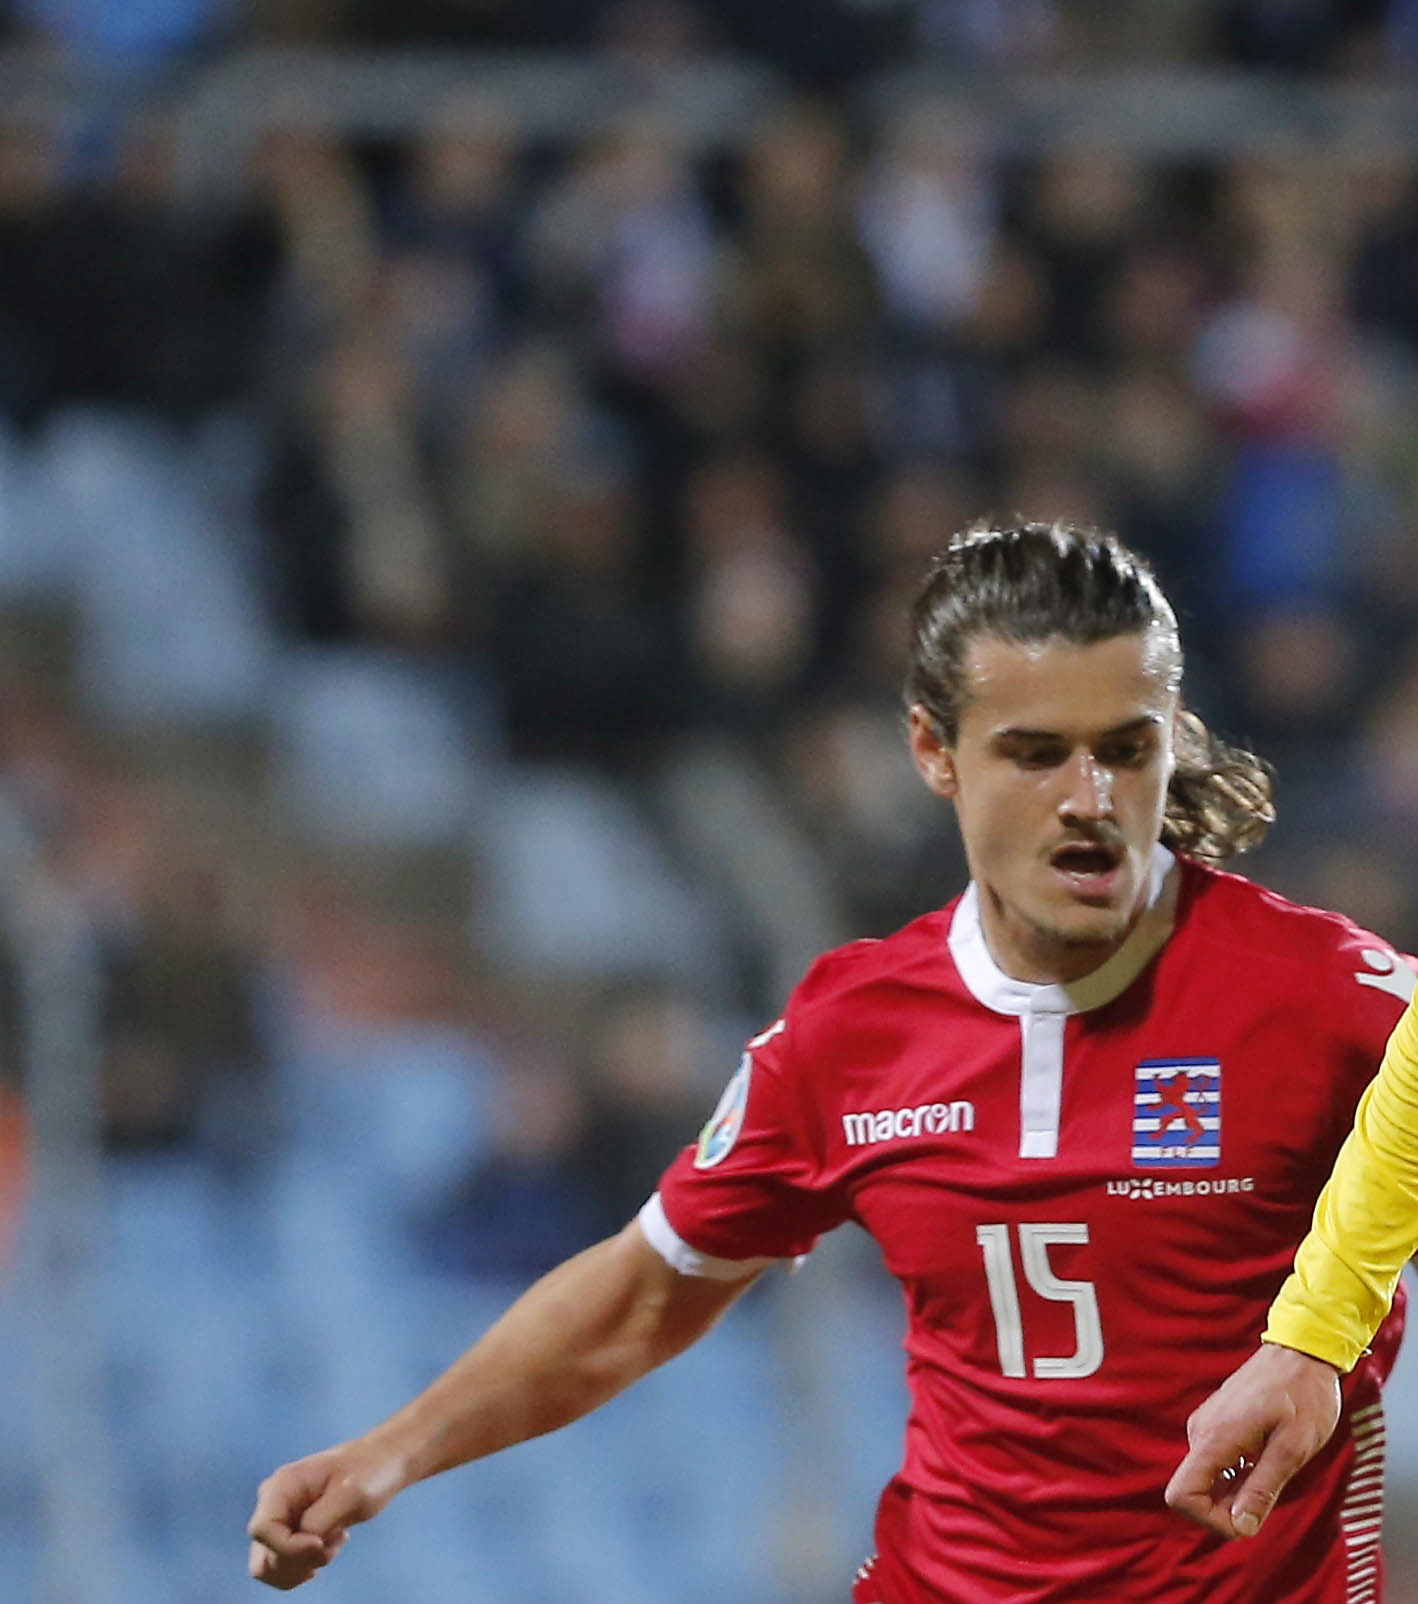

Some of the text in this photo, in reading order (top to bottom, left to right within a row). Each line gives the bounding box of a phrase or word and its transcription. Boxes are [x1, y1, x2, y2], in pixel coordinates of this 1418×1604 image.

[842, 1100, 975, 1146] macron
[1106, 1177, 1255, 1200] LUXEMBOURG
[976, 1223, 1105, 1379] 15
